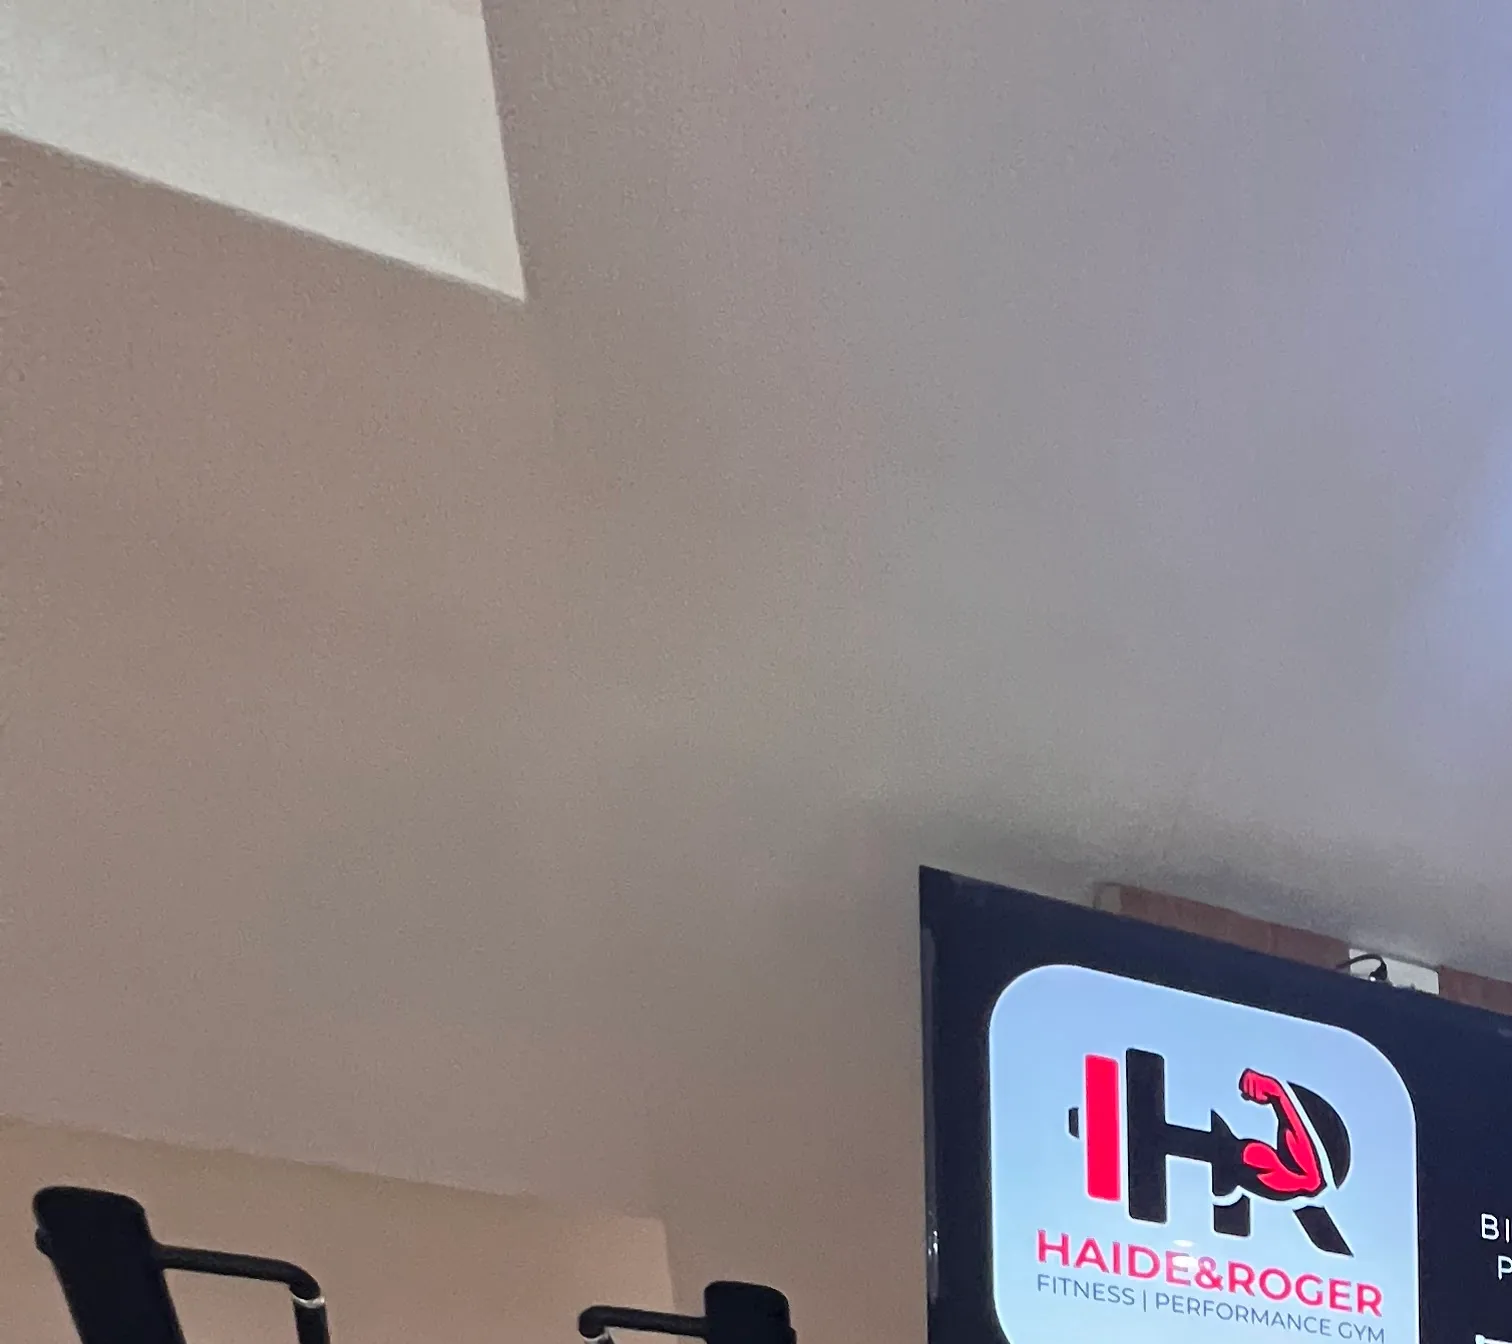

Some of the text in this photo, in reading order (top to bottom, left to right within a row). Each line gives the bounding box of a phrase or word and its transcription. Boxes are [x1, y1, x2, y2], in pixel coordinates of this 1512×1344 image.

[1036, 1228, 1383, 1318] HAIDE&ROGER
[1037, 1273, 1135, 1306] FITNESS
[1155, 1293, 1332, 1337] PERFORMANCE
[1338, 1320, 1385, 1344] GYM
